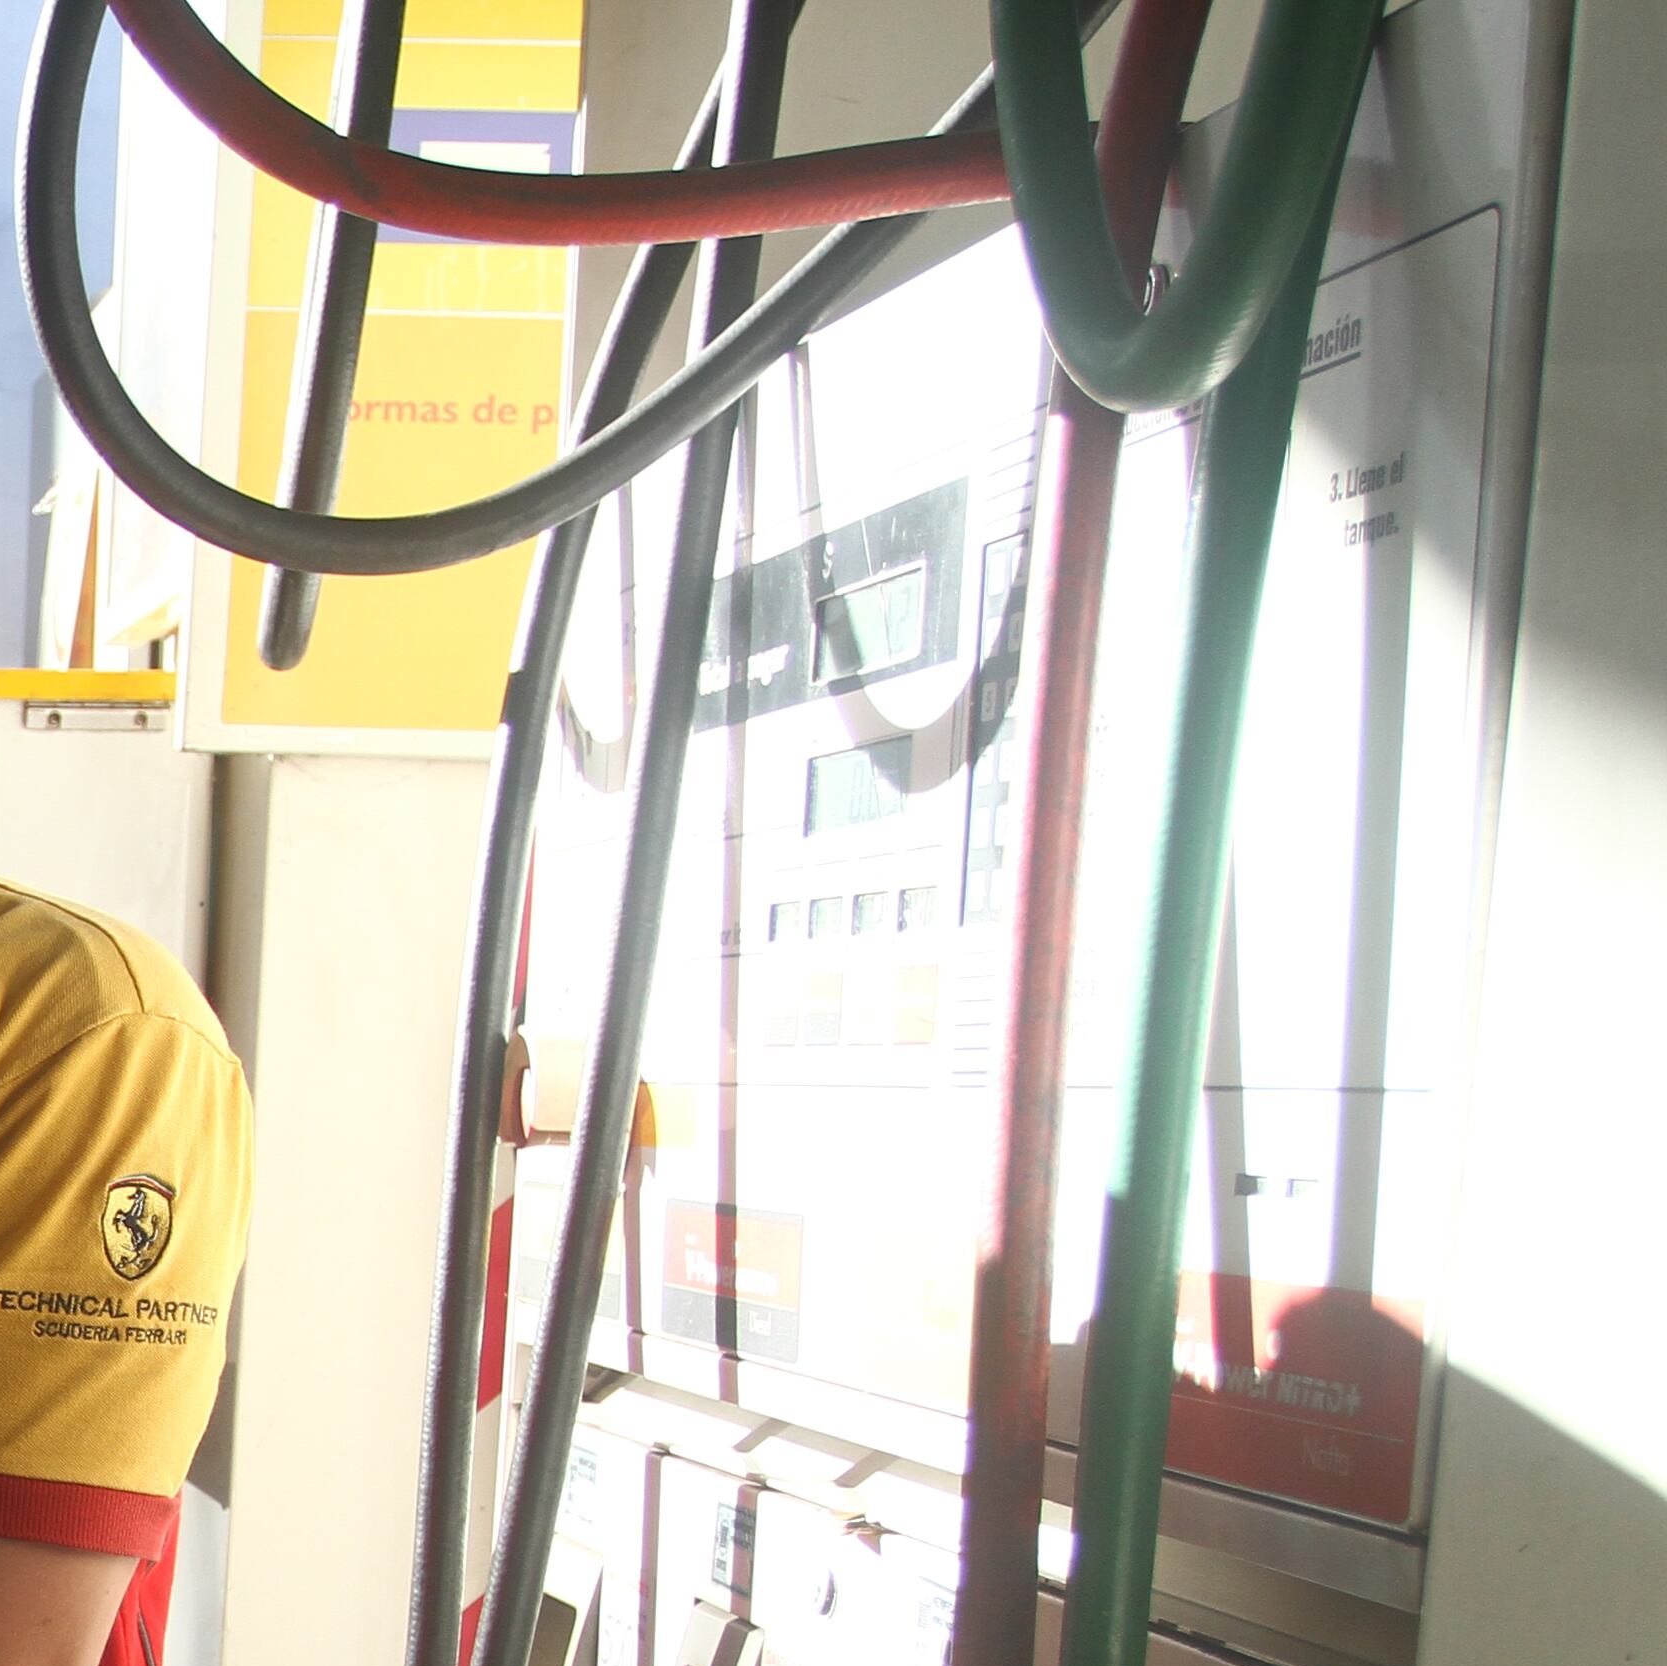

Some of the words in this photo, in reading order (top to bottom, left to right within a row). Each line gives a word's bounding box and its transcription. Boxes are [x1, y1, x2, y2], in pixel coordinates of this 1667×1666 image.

[473, 394, 518, 425] de
[1329, 472, 1343, 503] 3.
[1346, 463, 1386, 500] Llene
[1389, 451, 1404, 489] el
[1343, 510, 1400, 548] tanque.
[136, 1298, 219, 1326] PARTNER
[33, 1319, 121, 1342] SCUDERIA
[124, 1326, 187, 1345] FERRARI
